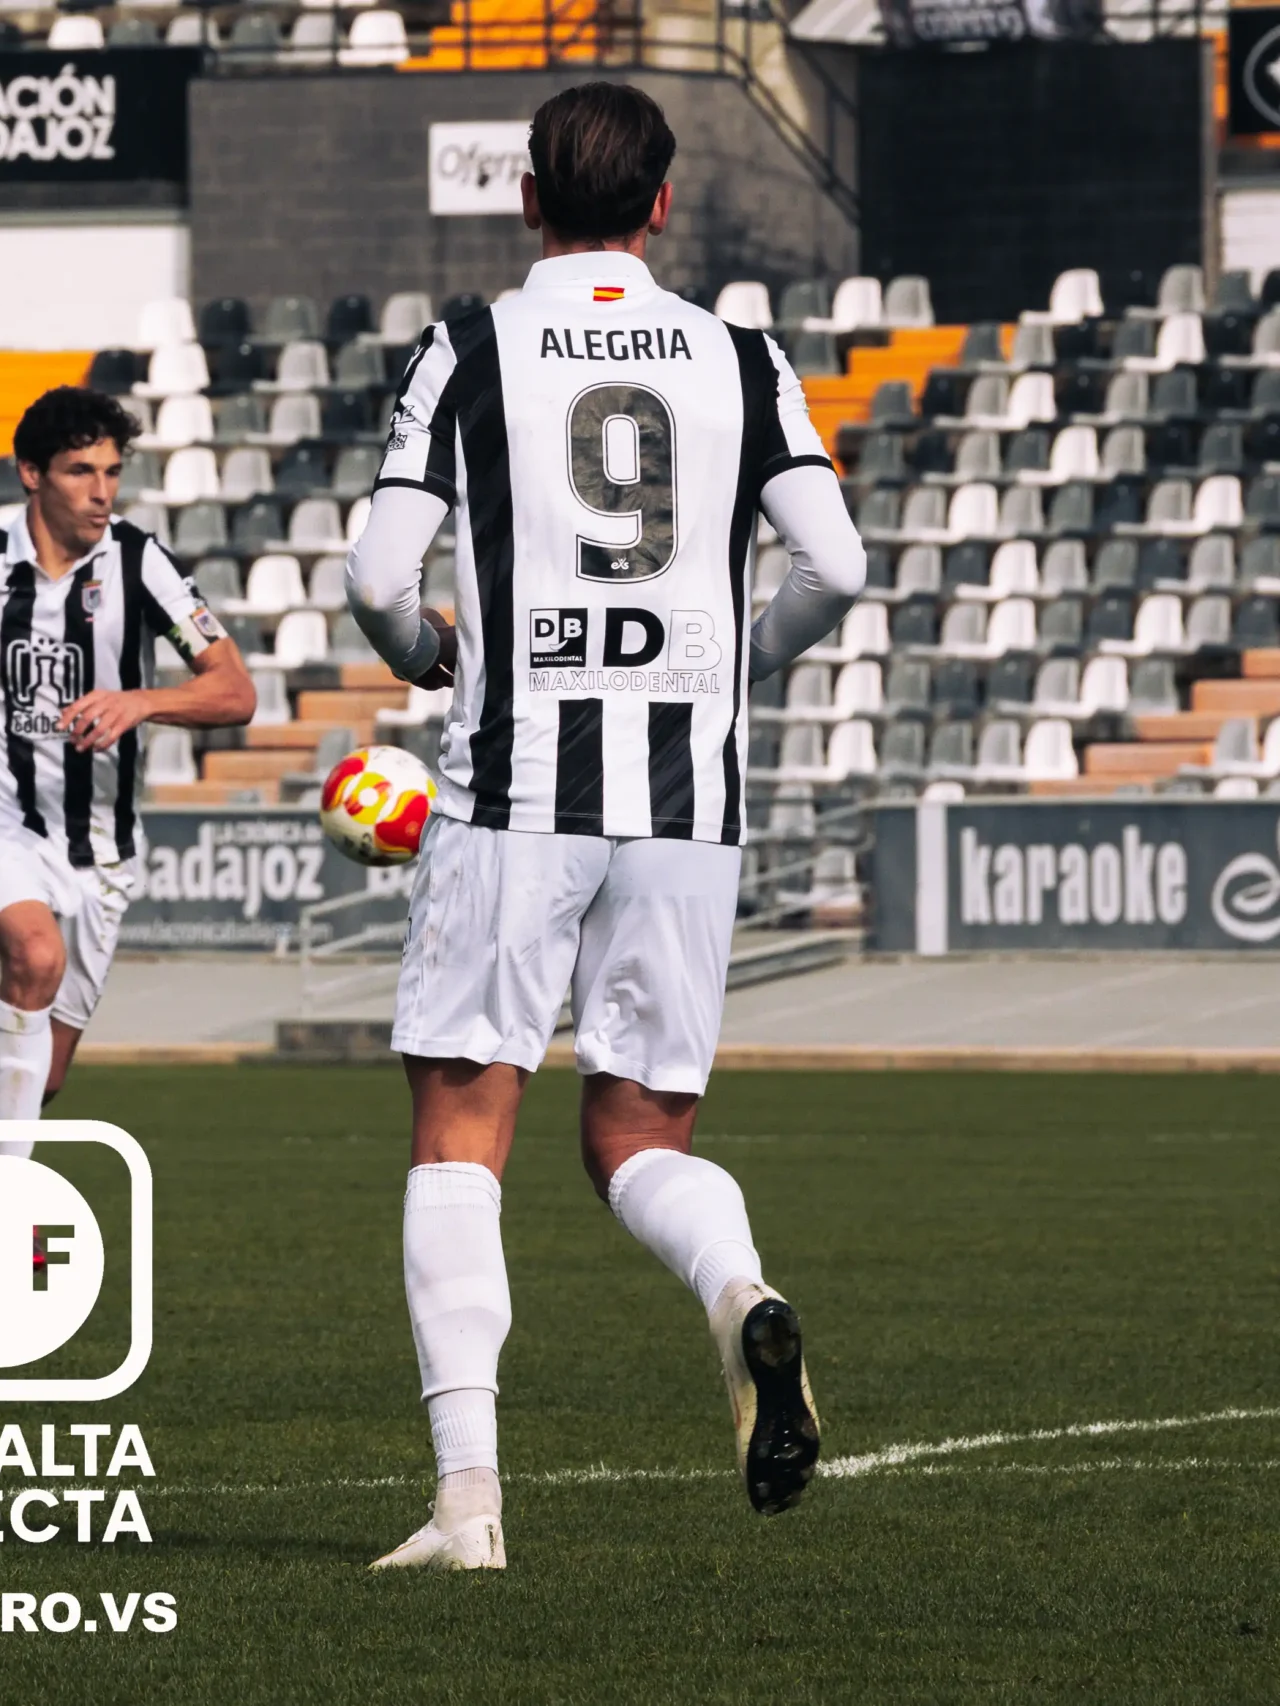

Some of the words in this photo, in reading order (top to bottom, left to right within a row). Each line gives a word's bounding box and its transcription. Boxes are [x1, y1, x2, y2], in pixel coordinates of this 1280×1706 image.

[540, 327, 692, 361] ALEGRIA
[565, 381, 678, 584] 9
[533, 655, 583, 663] MAXILODENTAL
[602, 607, 722, 671] DB
[529, 671, 720, 693] MAXILODENTAL
[961, 825, 1188, 924] karaoke
